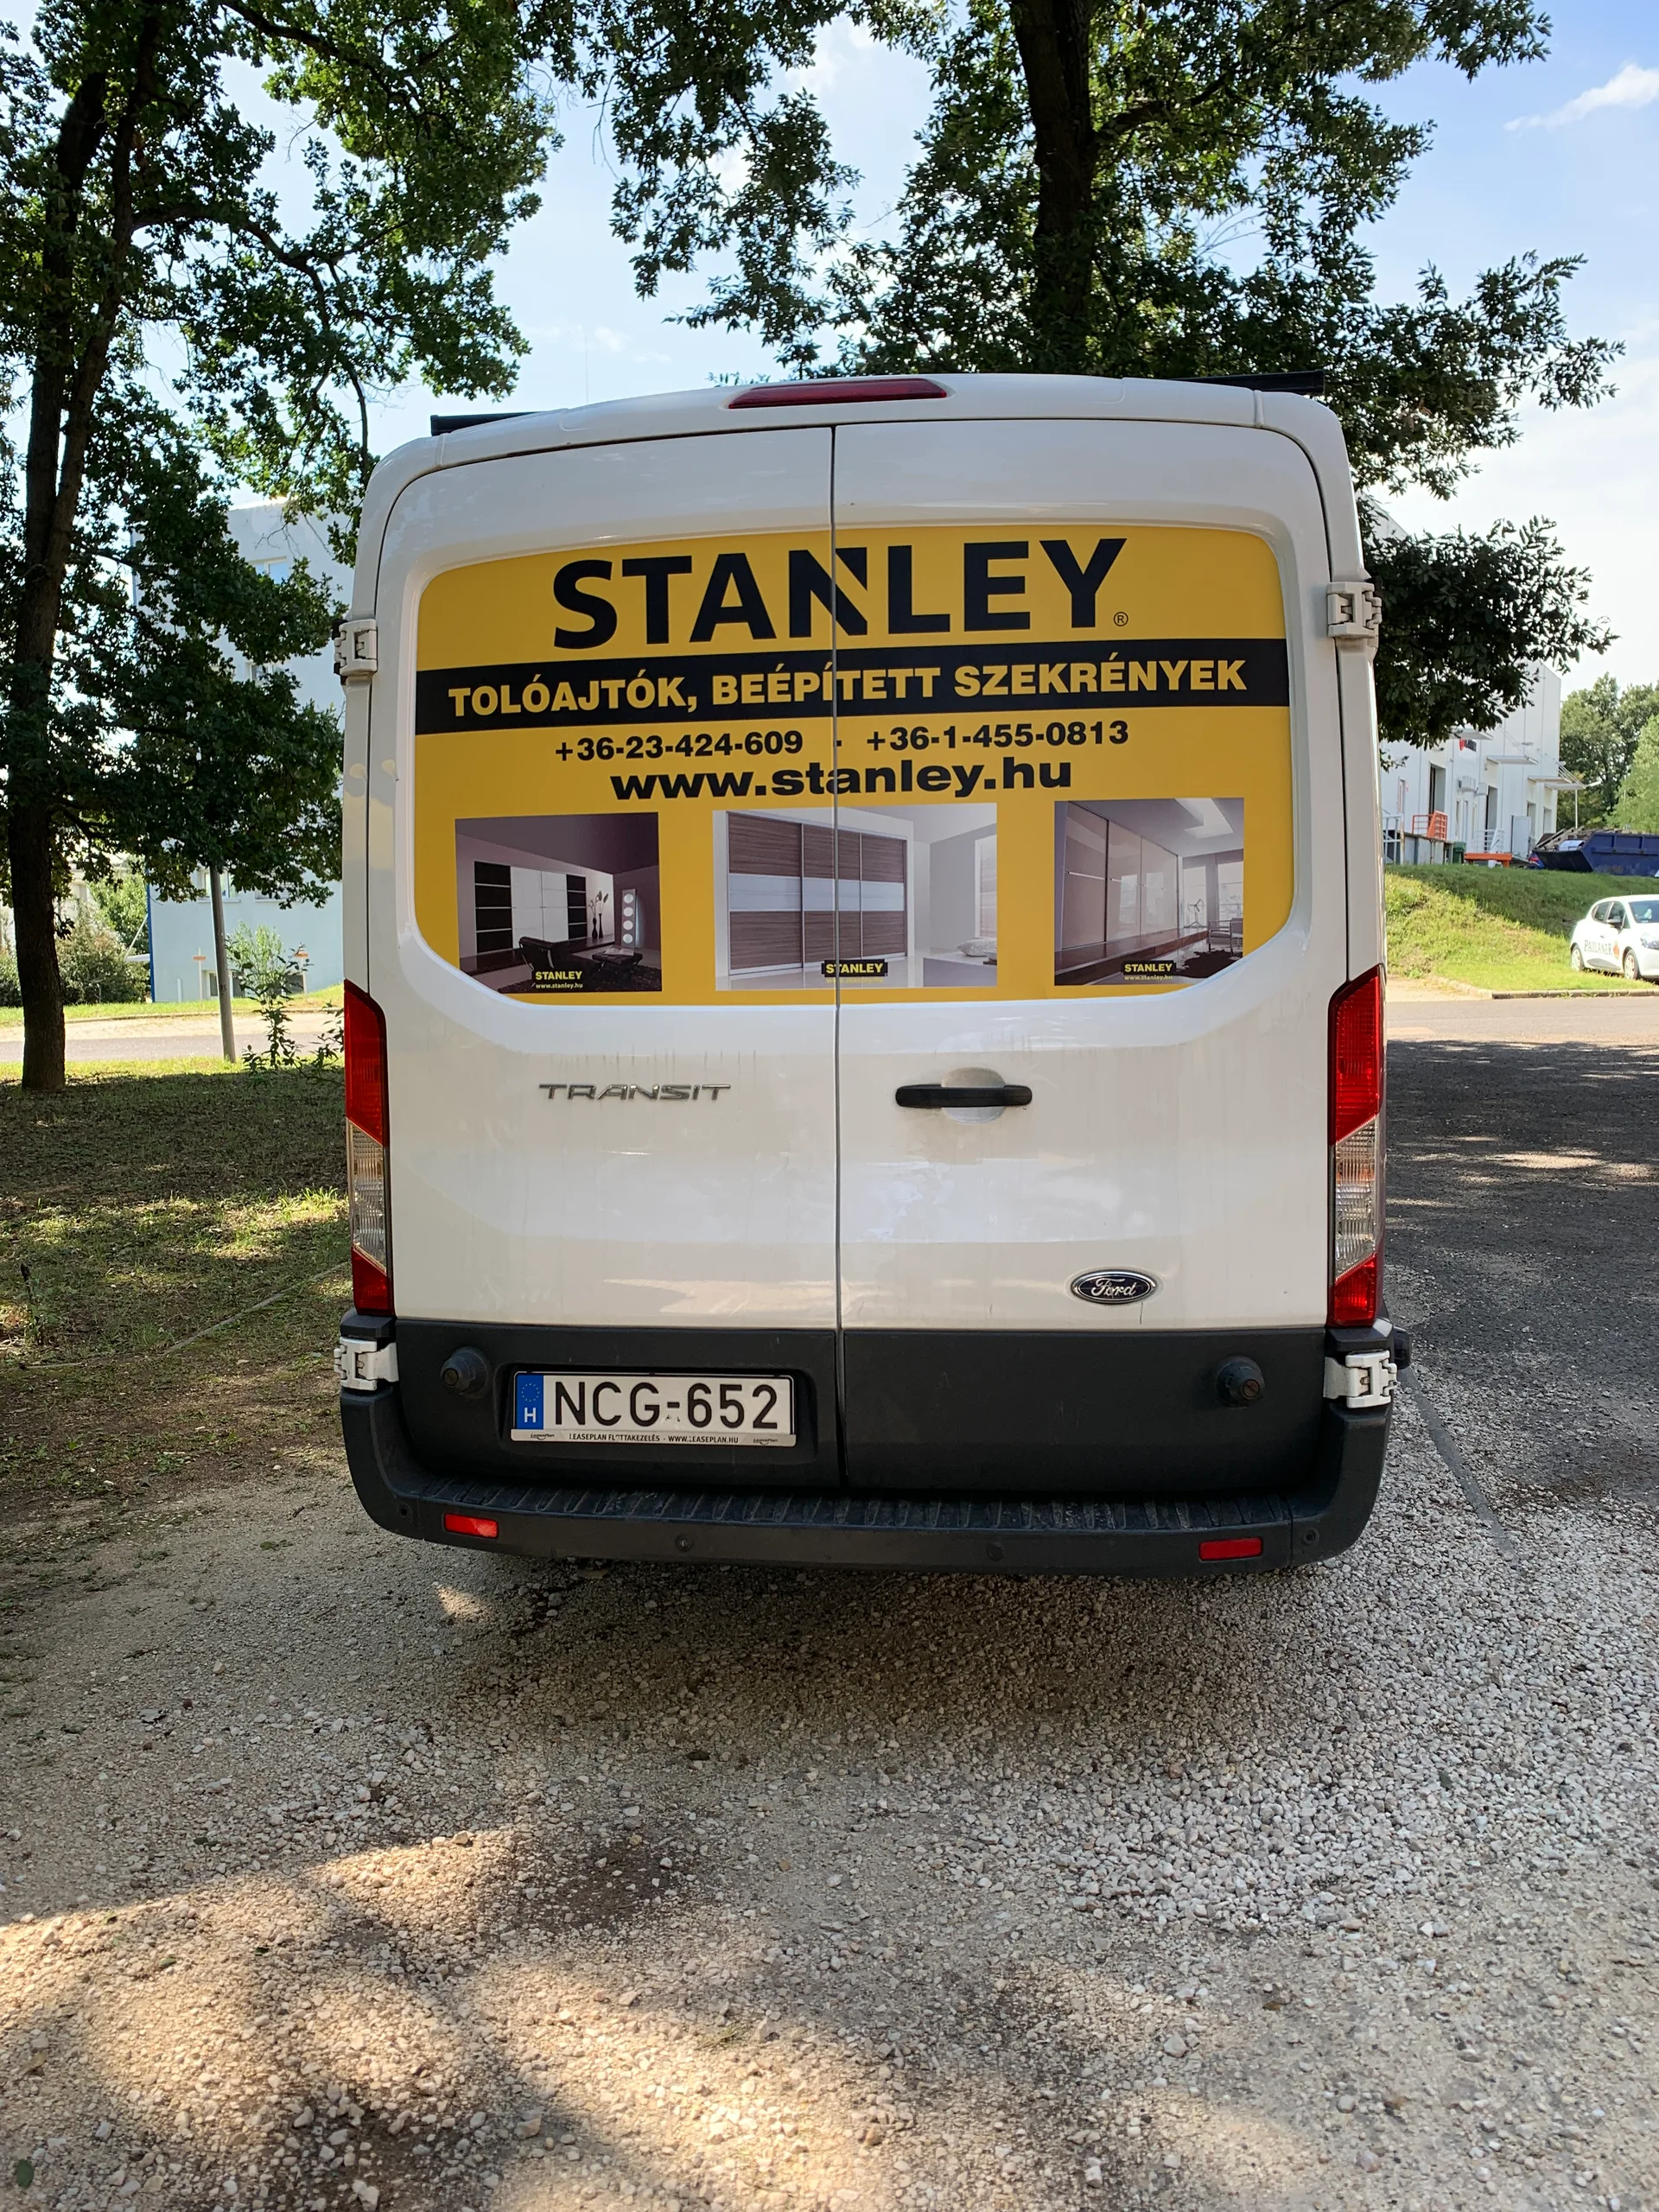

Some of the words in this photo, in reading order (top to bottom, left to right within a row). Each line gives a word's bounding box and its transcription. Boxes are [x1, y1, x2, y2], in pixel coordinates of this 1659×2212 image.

[553, 537, 1128, 650] STANLEY
[448, 669, 697, 717] TOLÓAJTÓK,
[712, 661, 941, 706] BEÉPÍTETT
[954, 652, 1248, 697] SZEKRÉNYEK
[556, 730, 803, 762] +36-23-424-609
[867, 721, 1129, 751] +36-1-455-0813
[610, 757, 1072, 800] www.stanley.hu
[536, 971, 582, 981] STANLEY
[1124, 963, 1173, 972] STANLEY
[539, 1084, 732, 1101] TRANSIT
[1091, 1278, 1137, 1296] Ford
[524, 1407, 537, 1423] H
[555, 1381, 779, 1430] NCG-652
